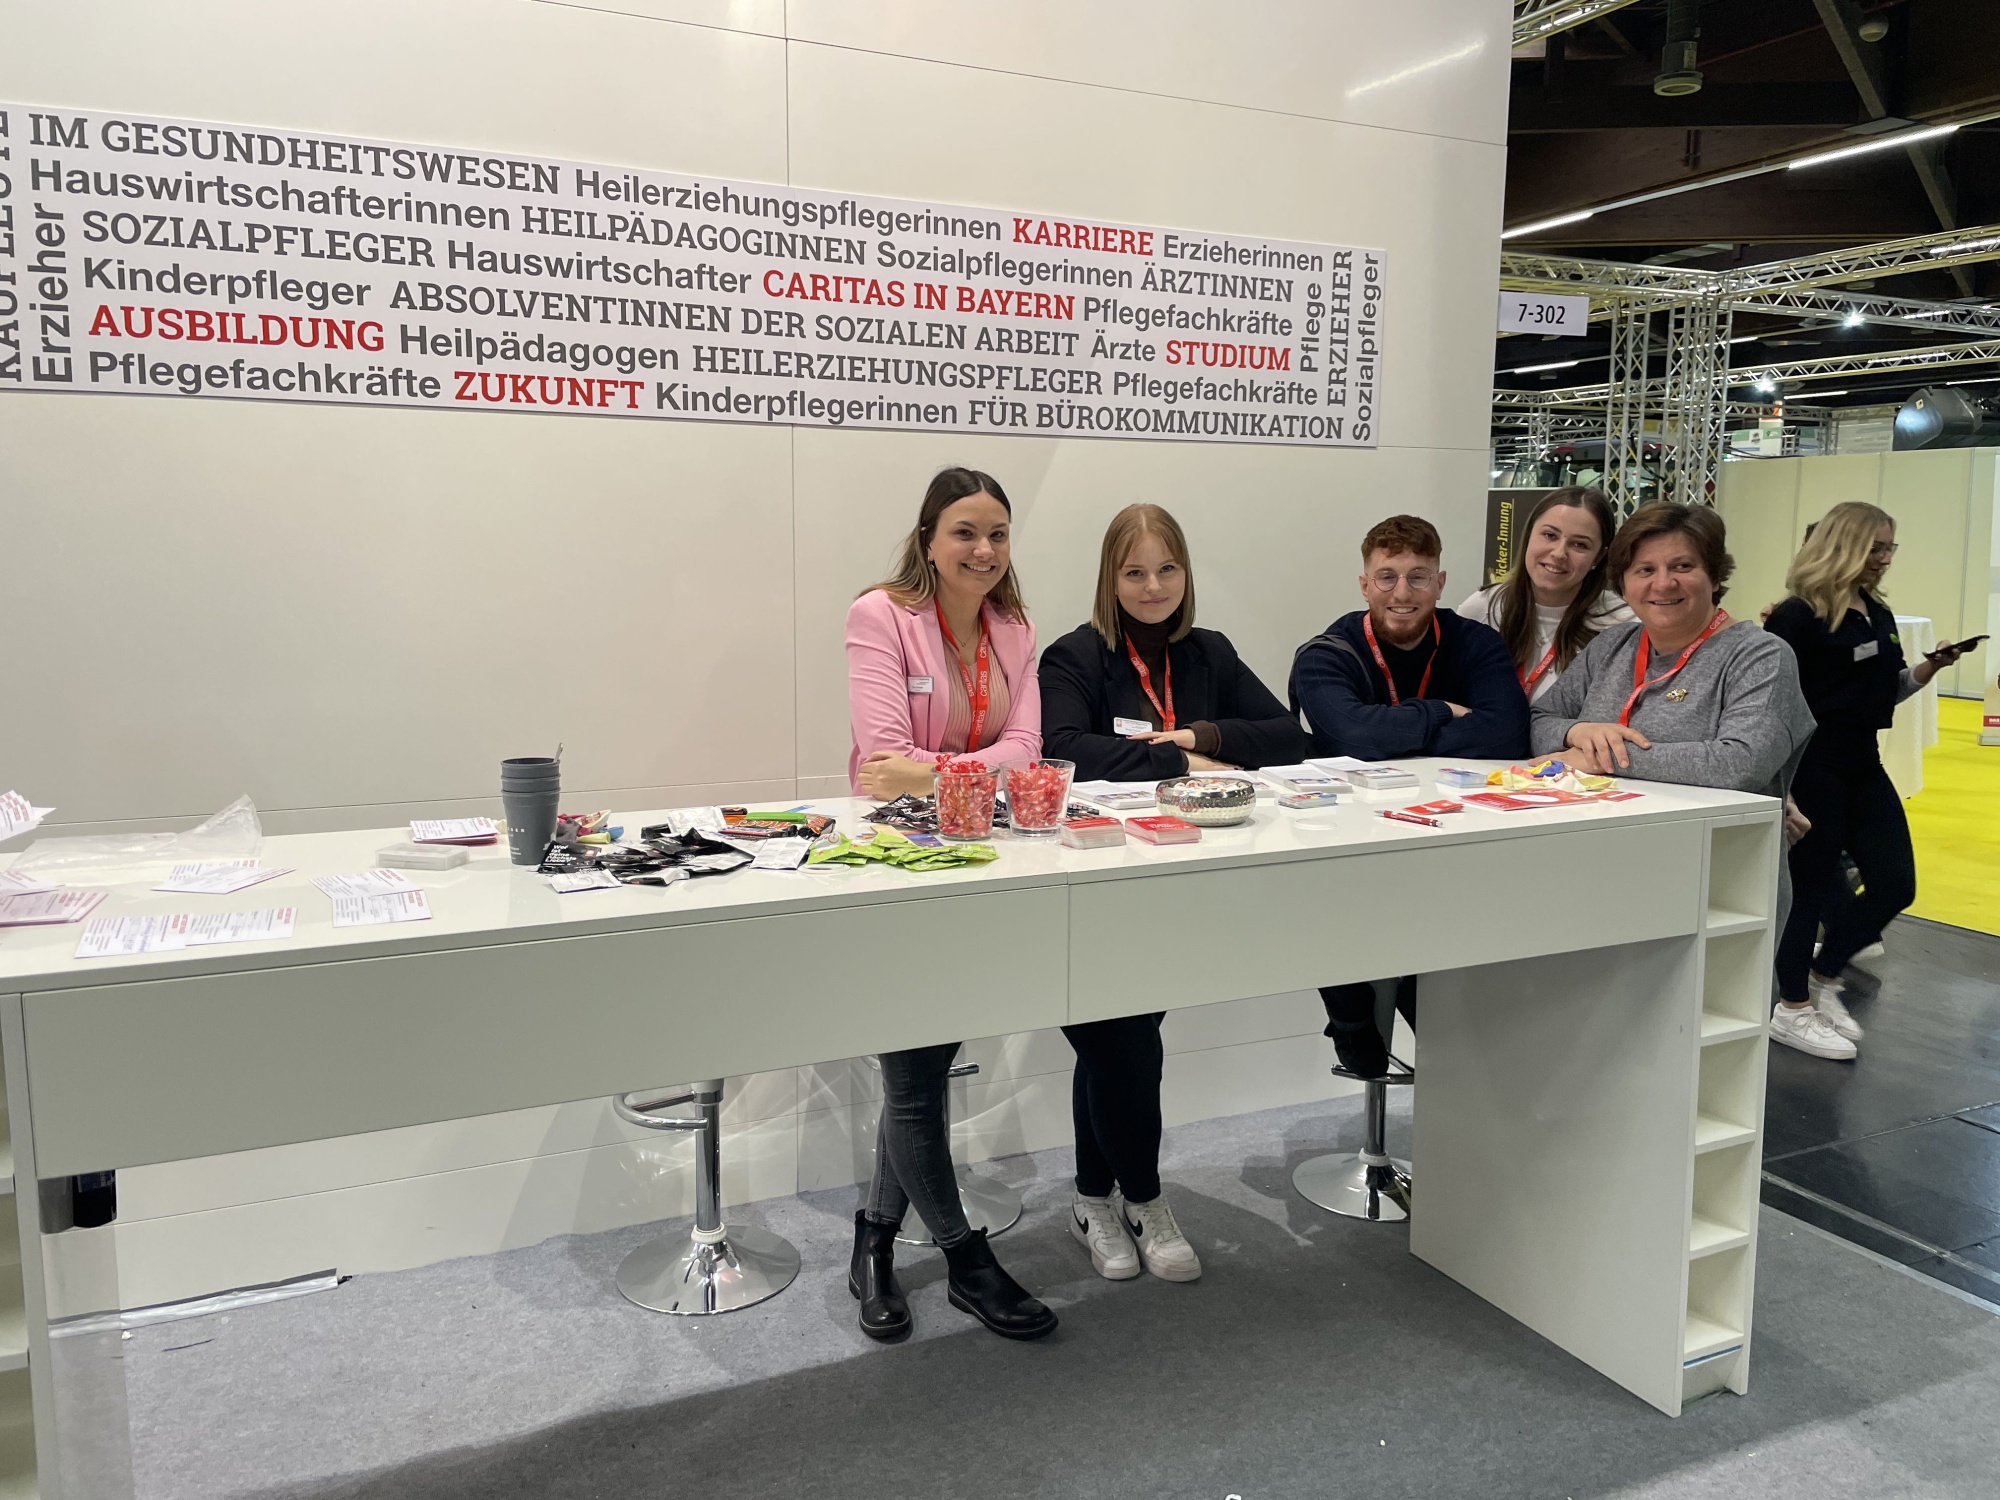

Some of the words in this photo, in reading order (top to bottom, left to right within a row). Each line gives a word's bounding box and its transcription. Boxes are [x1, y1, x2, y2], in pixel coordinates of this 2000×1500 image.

[29, 114, 88, 149] IM
[102, 121, 560, 194] GESUNDHEITSWESEN
[576, 169, 1000, 240] Heilerziehungspflegerinnen
[1013, 218, 1153, 256] KARRIERE
[1164, 235, 1322, 272] Erzieherinnen
[31, 159, 509, 230] Hauswirtschafterinnen
[522, 206, 866, 265] HEILPÄDAGOGINNEN
[877, 241, 1132, 288] Sozialpflegerinnen
[1141, 262, 1293, 302] ÄRZTINNEN
[27, 203, 72, 382] Erzieher
[83, 211, 435, 267] SOZIALPFLEGER
[448, 240, 751, 293] Hauswirtschafter
[764, 270, 904, 307] CARITAS
[914, 283, 948, 310] IN
[956, 286, 1075, 320] BAYERN
[1084, 297, 1292, 336] Pflegefachkräfte
[84, 258, 371, 310] Kinderpfleger
[390, 281, 731, 332] ABSOLVENTINNEN
[741, 308, 806, 338] DER
[816, 315, 967, 349] SOZIALEN
[975, 327, 1079, 356] ARBEIT
[1091, 336, 1155, 361] Ärzte
[1167, 340, 1291, 371] STUDIUM
[1300, 283, 1325, 372] Pflege
[1327, 251, 1352, 407] ERZIEHER
[1518, 303, 1565, 325] 7-302
[89, 305, 384, 351] AUSBILDUNG
[401, 324, 678, 374] Heilpädagogen
[693, 345, 1102, 395] HEILERZIEHUNGSPFLEGER
[1114, 372, 1317, 405] Pflegefachkräfte
[90, 351, 440, 398] Pflegefachkräfte
[455, 371, 644, 408] ZUKUNFT
[656, 382, 957, 425] Kinderpflegerinnen
[969, 396, 1028, 427] FÜR
[1036, 399, 1344, 439] BÜROKOMMUNIKATION
[1353, 253, 1381, 441] Sozialpfleger
[980, 670, 988, 697] caritas
